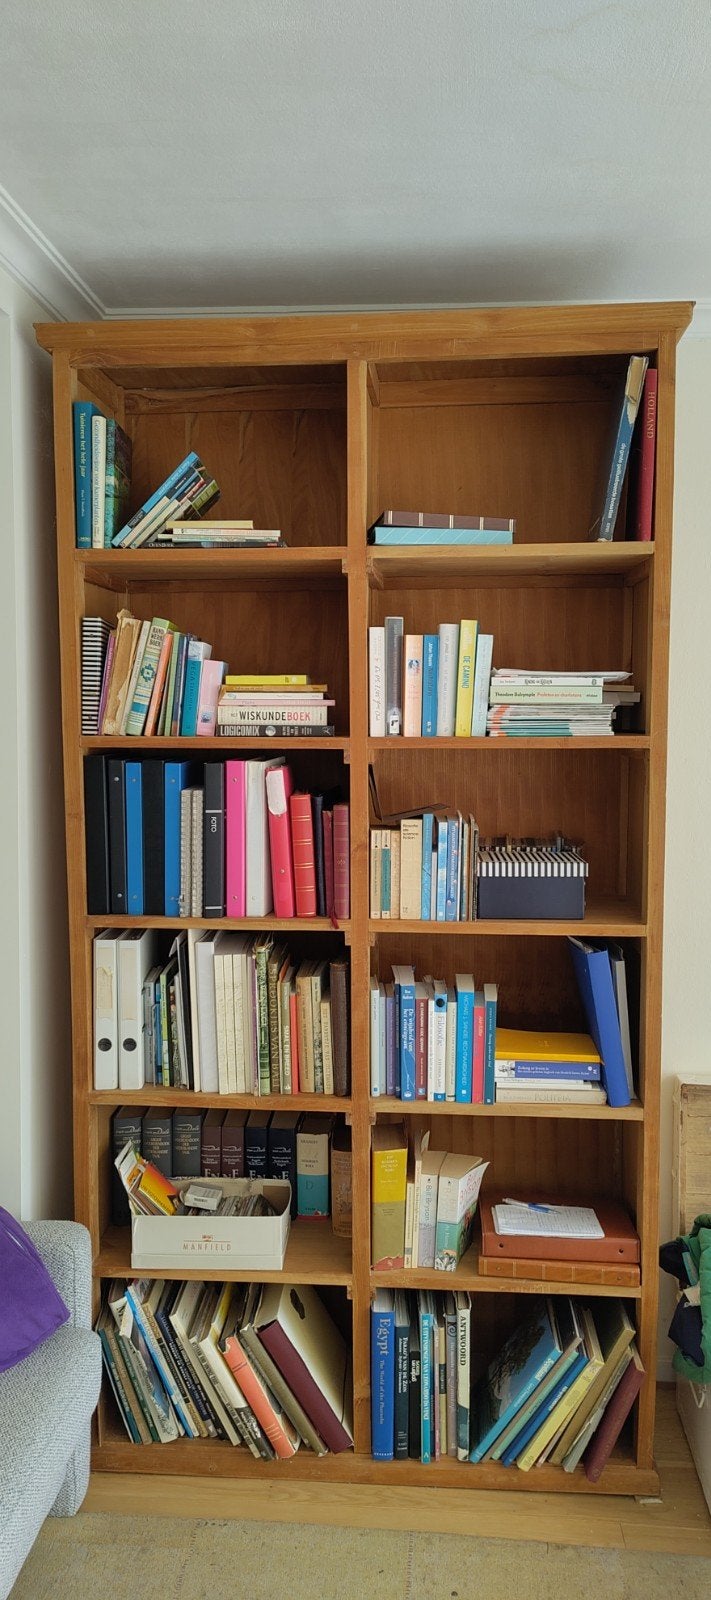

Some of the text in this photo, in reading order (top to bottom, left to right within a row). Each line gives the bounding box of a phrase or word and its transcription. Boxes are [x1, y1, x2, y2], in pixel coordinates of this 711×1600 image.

[648, 392, 656, 439] HOLLAND
[462, 656, 470, 688] DE CAMINO
[240, 711, 310, 721] WISKUNDEBOEK
[220, 725, 260, 736] LOGICOMIX
[270, 968, 278, 1032] SPROOKJES
[284, 1044, 289, 1053] EN
[183, 1243, 231, 1251] MANFIELD
[377, 1319, 390, 1356] Egypt
